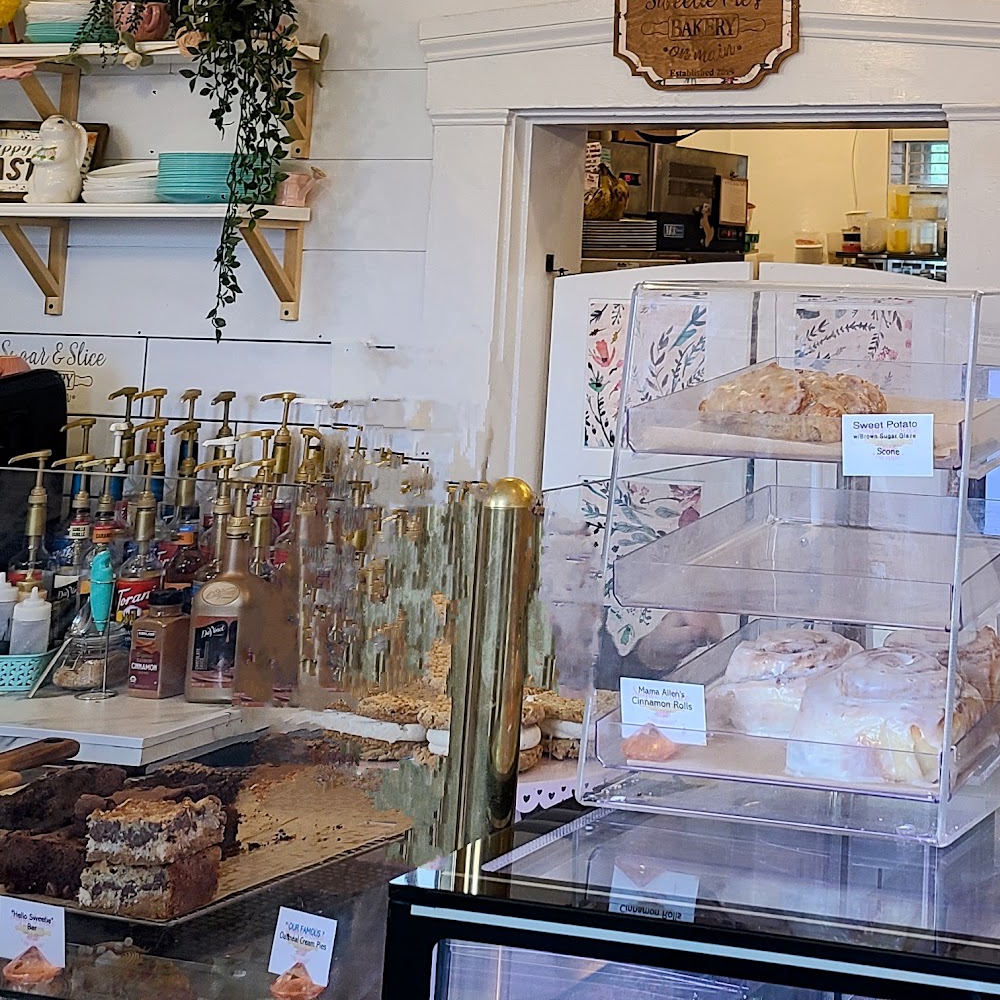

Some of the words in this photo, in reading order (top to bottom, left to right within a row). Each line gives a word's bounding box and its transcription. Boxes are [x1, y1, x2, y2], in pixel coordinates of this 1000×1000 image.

[671, 17, 736, 38] BAKERY
[67, 342, 106, 366] Slice
[853, 421, 883, 429] Sweet
[886, 420, 917, 428] Potato
[877, 447, 900, 455] Scone
[131, 662, 157, 672] CINNAMON
[638, 686, 659, 695] Mama
[632, 697, 670, 708] Cinnamon
[674, 700, 692, 711] Rolls
